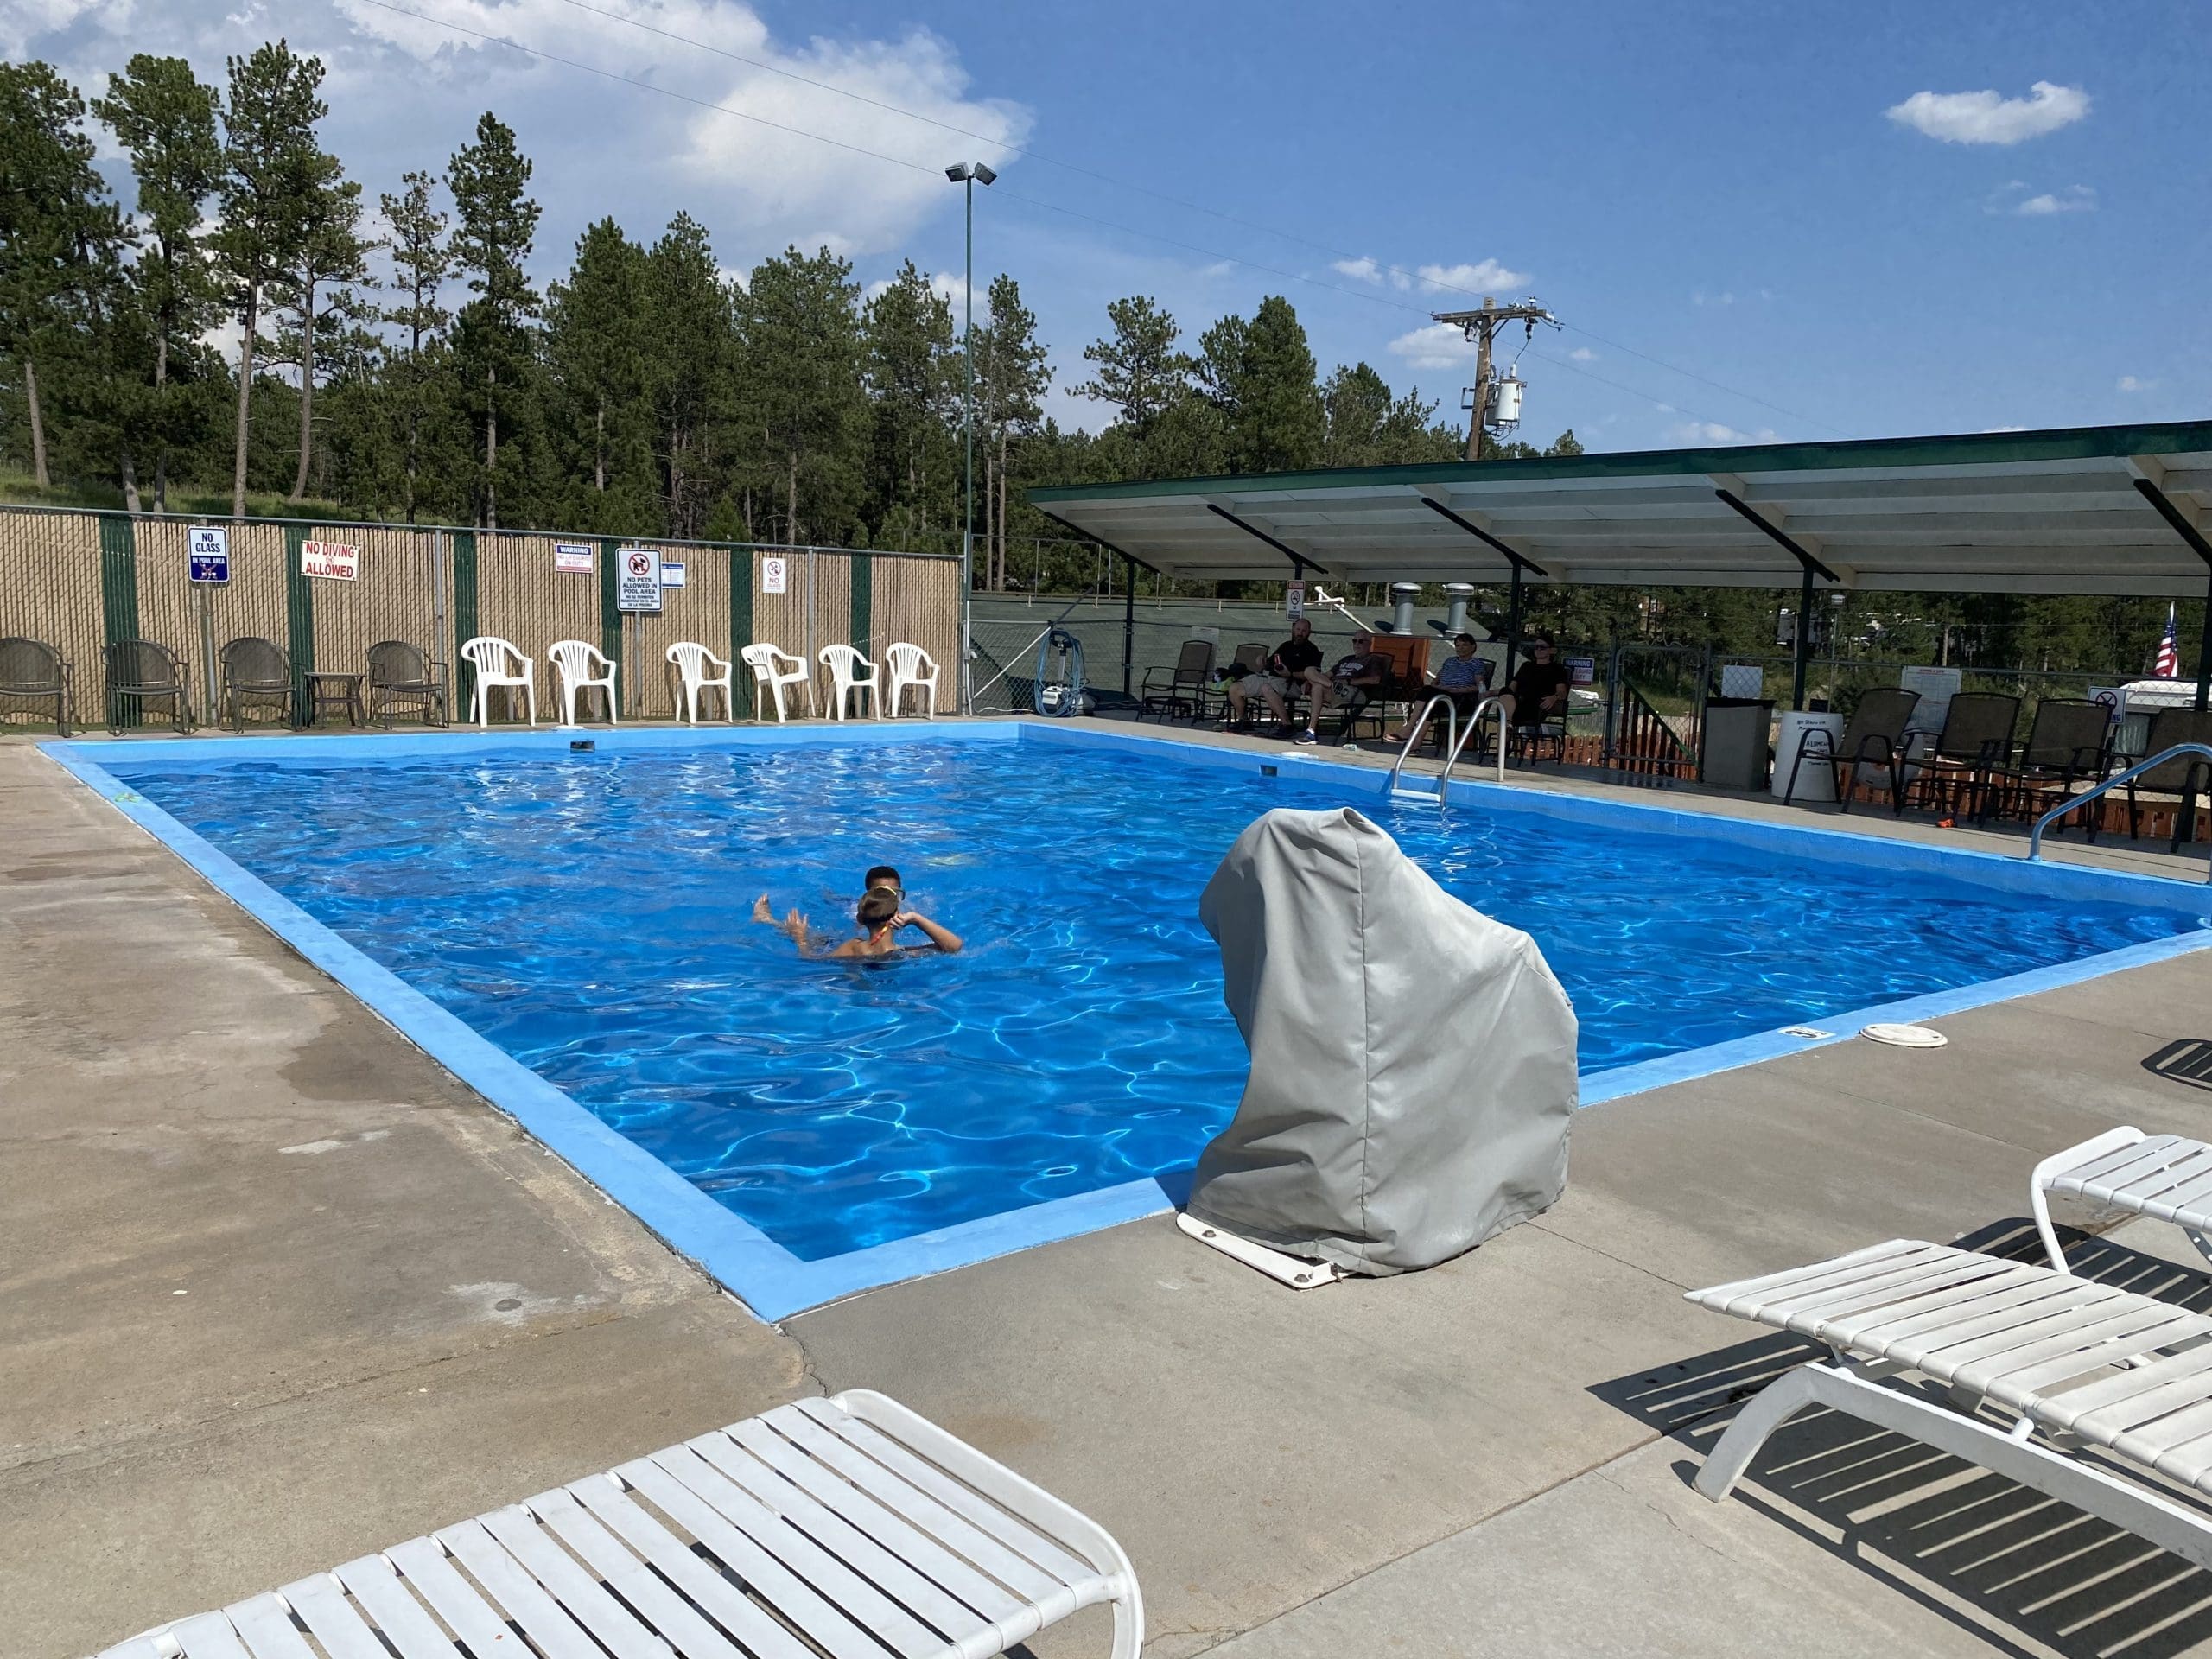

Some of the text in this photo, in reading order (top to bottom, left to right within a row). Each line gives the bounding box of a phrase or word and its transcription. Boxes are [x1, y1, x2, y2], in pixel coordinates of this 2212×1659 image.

[201, 532, 213, 543] NO
[195, 543, 221, 553] GLASS
[306, 542, 354, 558] NO DIVING
[560, 546, 589, 555] WARNING
[305, 562, 353, 578] ALLOWED
